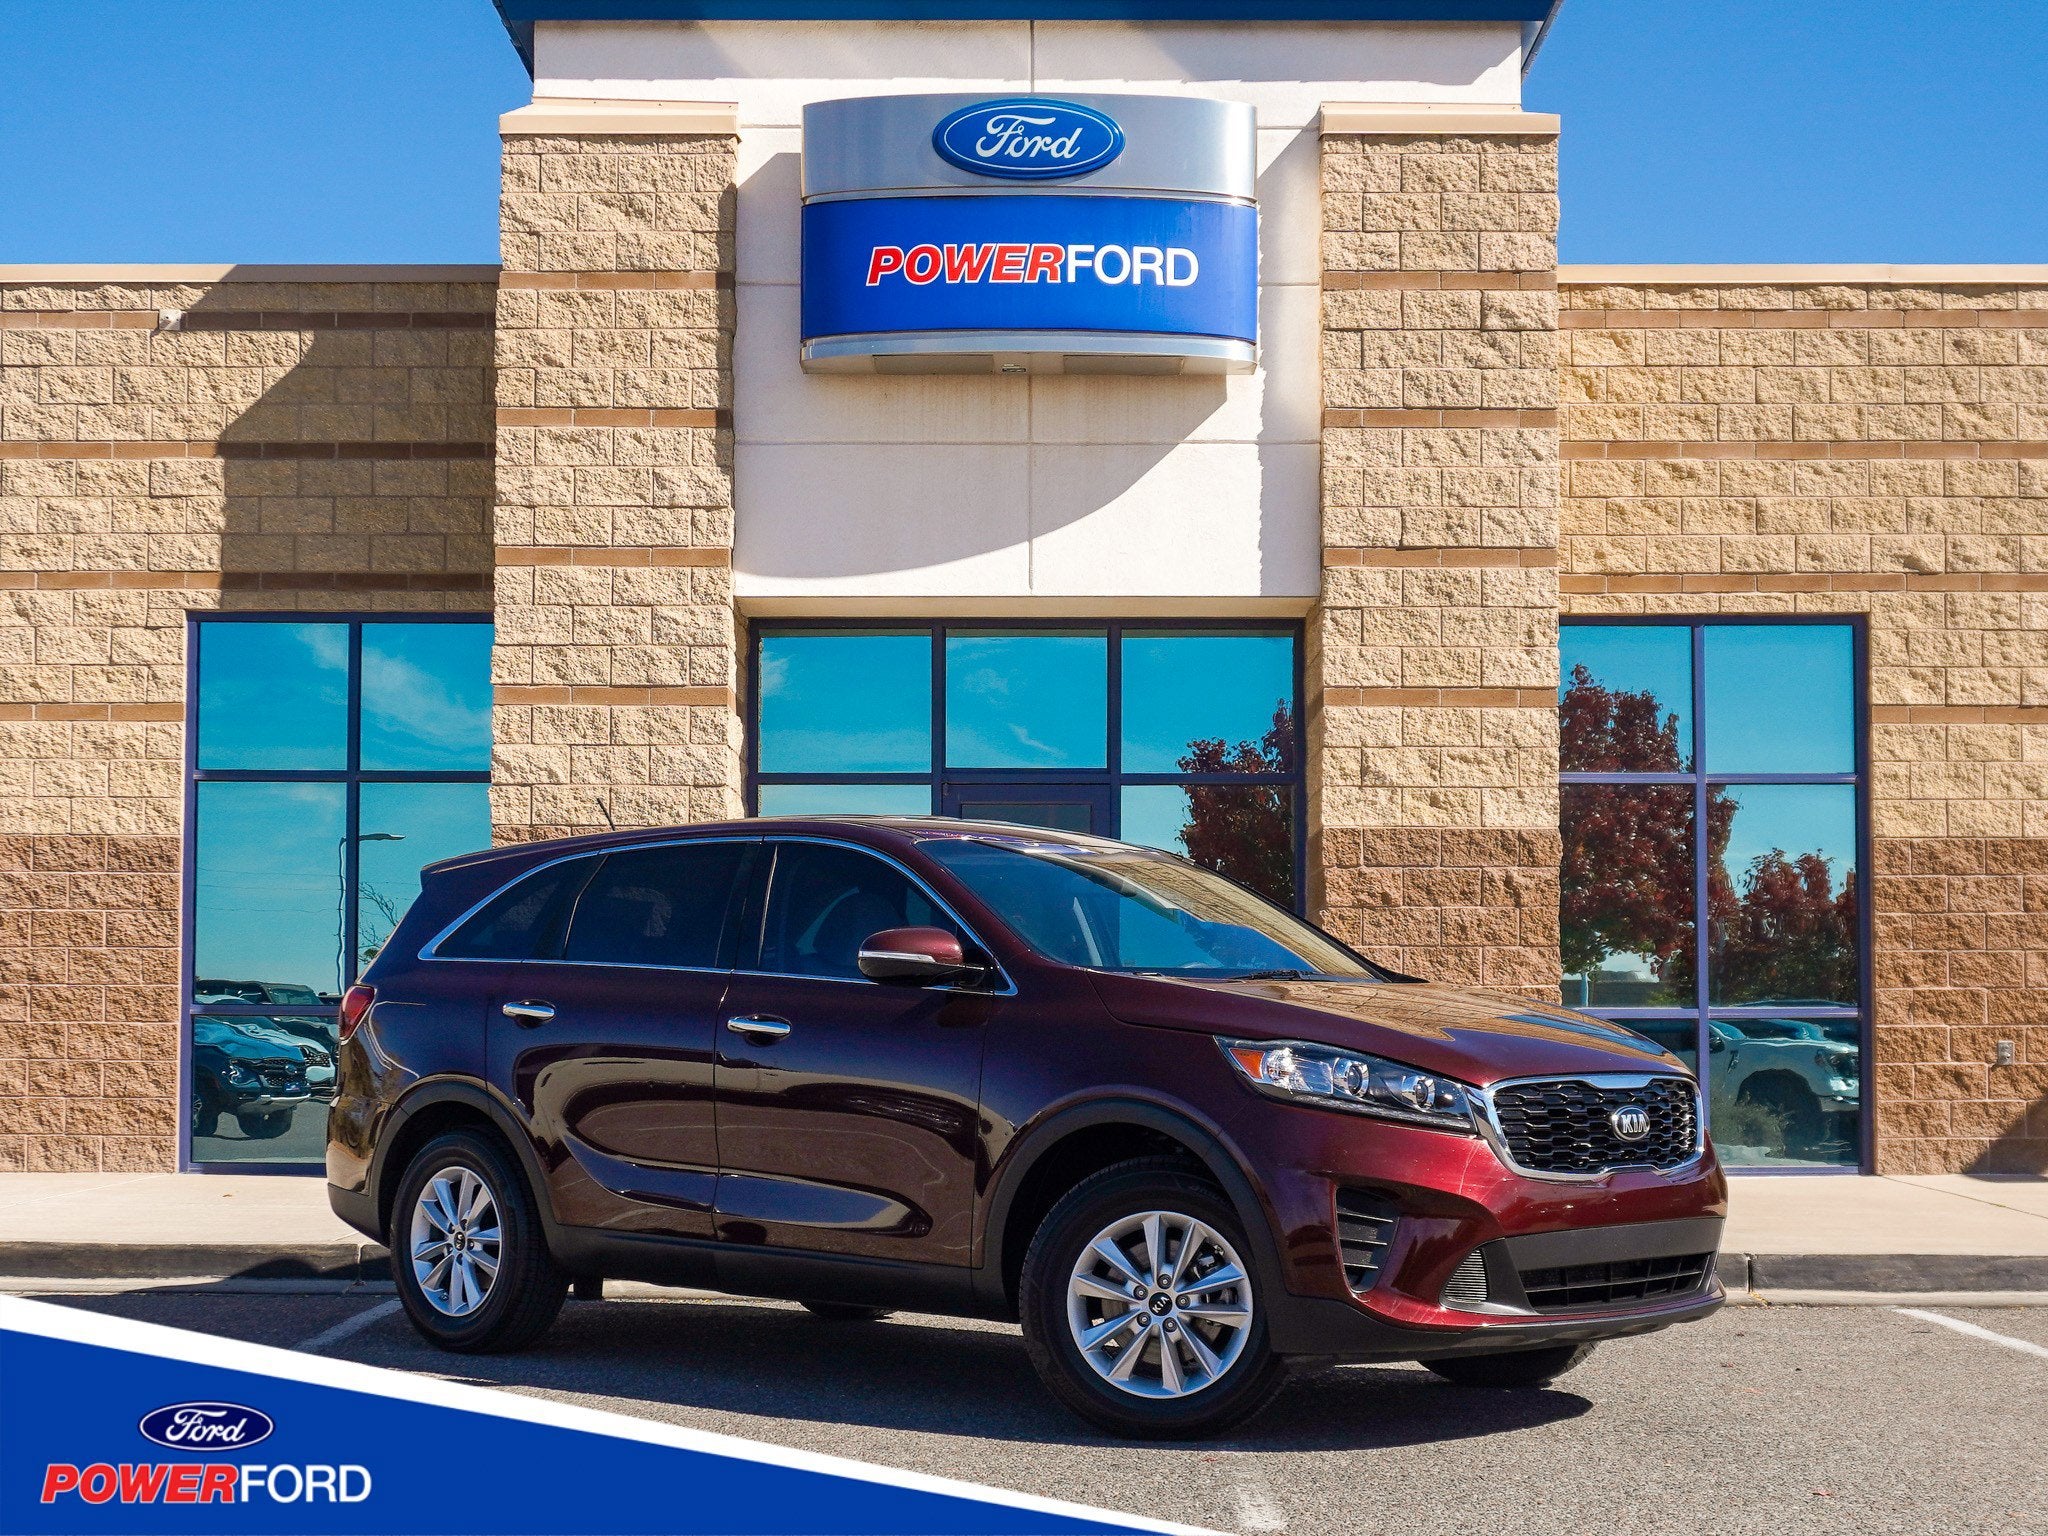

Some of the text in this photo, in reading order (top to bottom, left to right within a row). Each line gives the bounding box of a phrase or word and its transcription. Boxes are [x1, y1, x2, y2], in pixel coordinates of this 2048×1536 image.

[975, 114, 1083, 159] Ford
[866, 243, 1199, 286] POWERFORD
[1621, 1114, 1647, 1133] KIA
[1152, 1296, 1169, 1314] KIA
